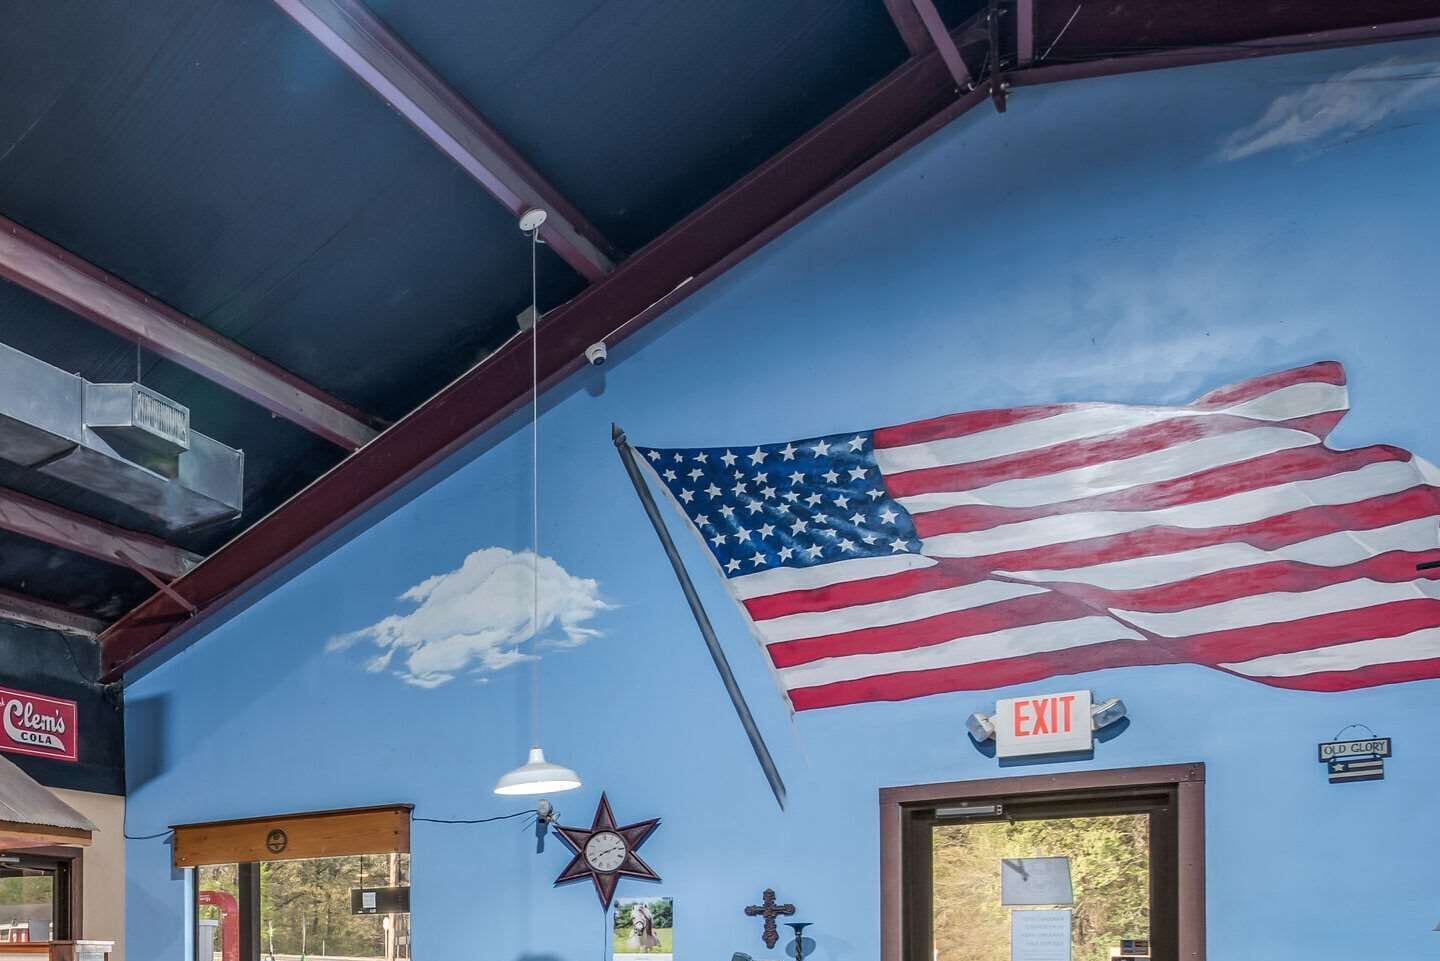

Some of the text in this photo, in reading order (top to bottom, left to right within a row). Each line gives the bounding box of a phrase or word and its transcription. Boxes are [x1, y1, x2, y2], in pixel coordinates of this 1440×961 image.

[3, 699, 65, 737] Clem's
[1013, 695, 1076, 737] EXIT
[21, 732, 52, 745] COLA
[1323, 741, 1386, 755] OLD GLORY
